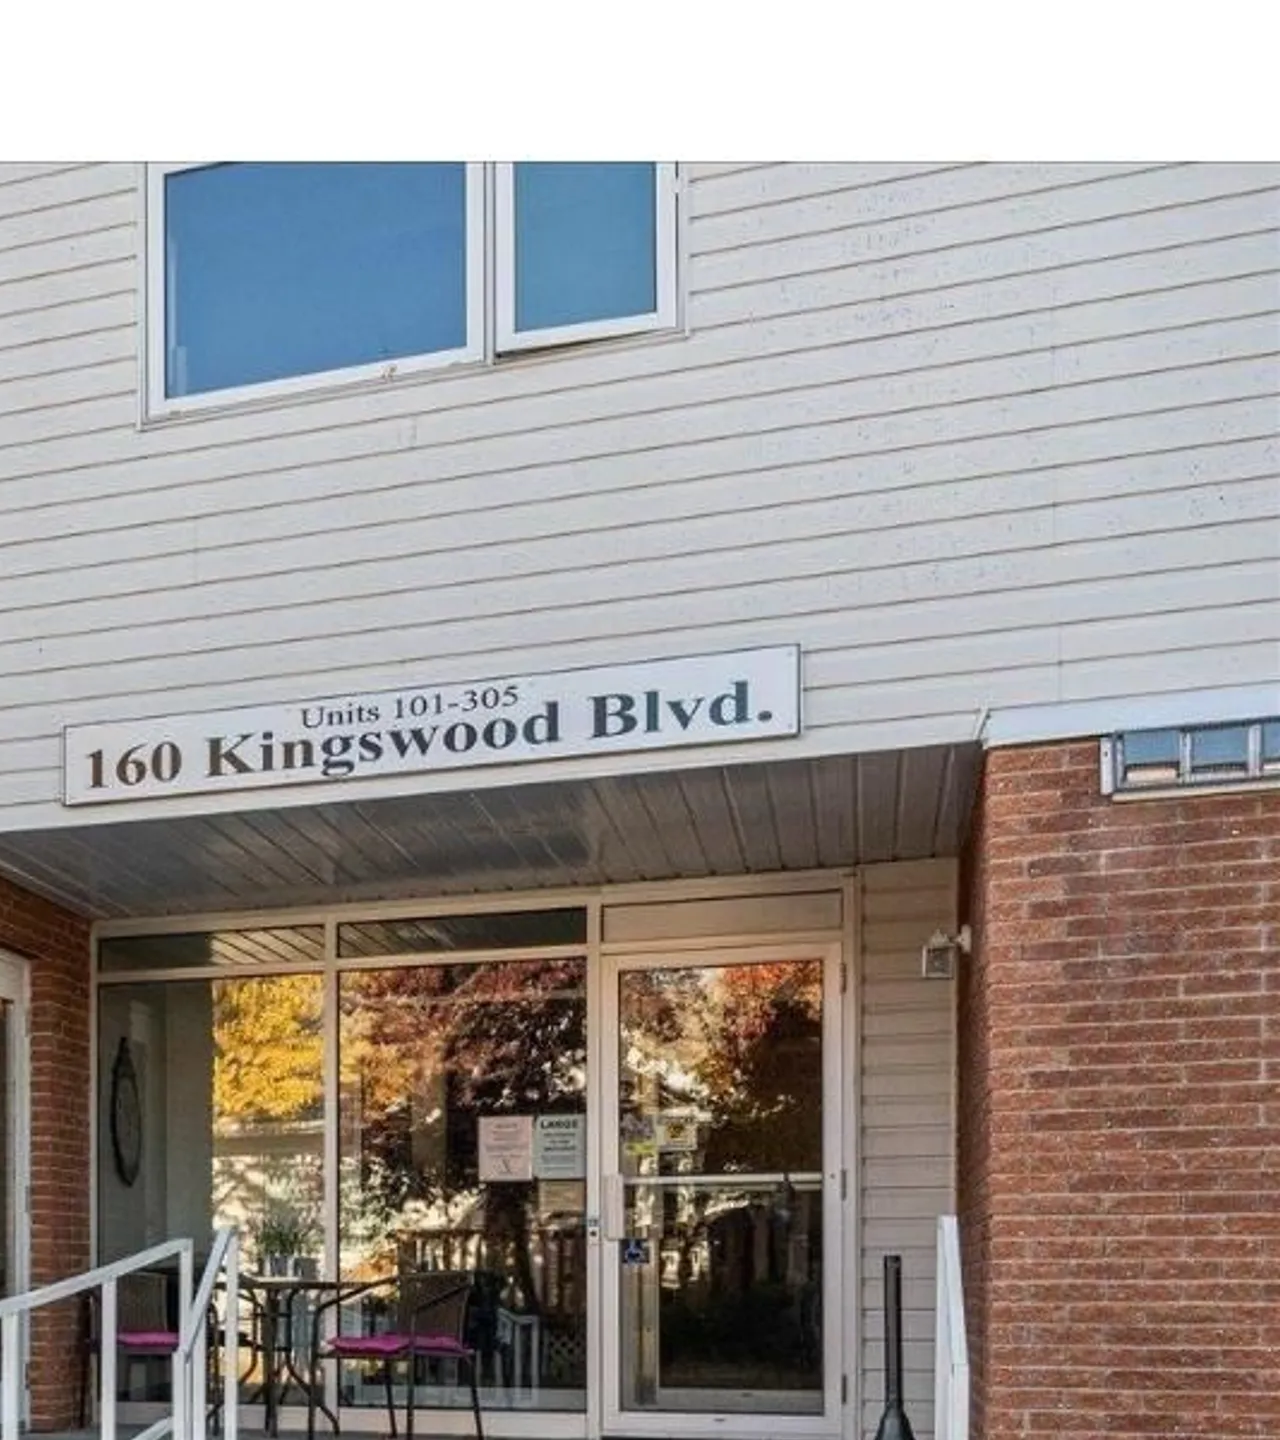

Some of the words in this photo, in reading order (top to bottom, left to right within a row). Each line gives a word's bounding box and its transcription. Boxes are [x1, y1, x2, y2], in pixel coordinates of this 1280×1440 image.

[88, 740, 183, 789] 160
[205, 700, 561, 778] Kingswood
[588, 679, 773, 740] Blvd.
[301, 703, 380, 729] Units
[394, 684, 519, 720] 101-305
